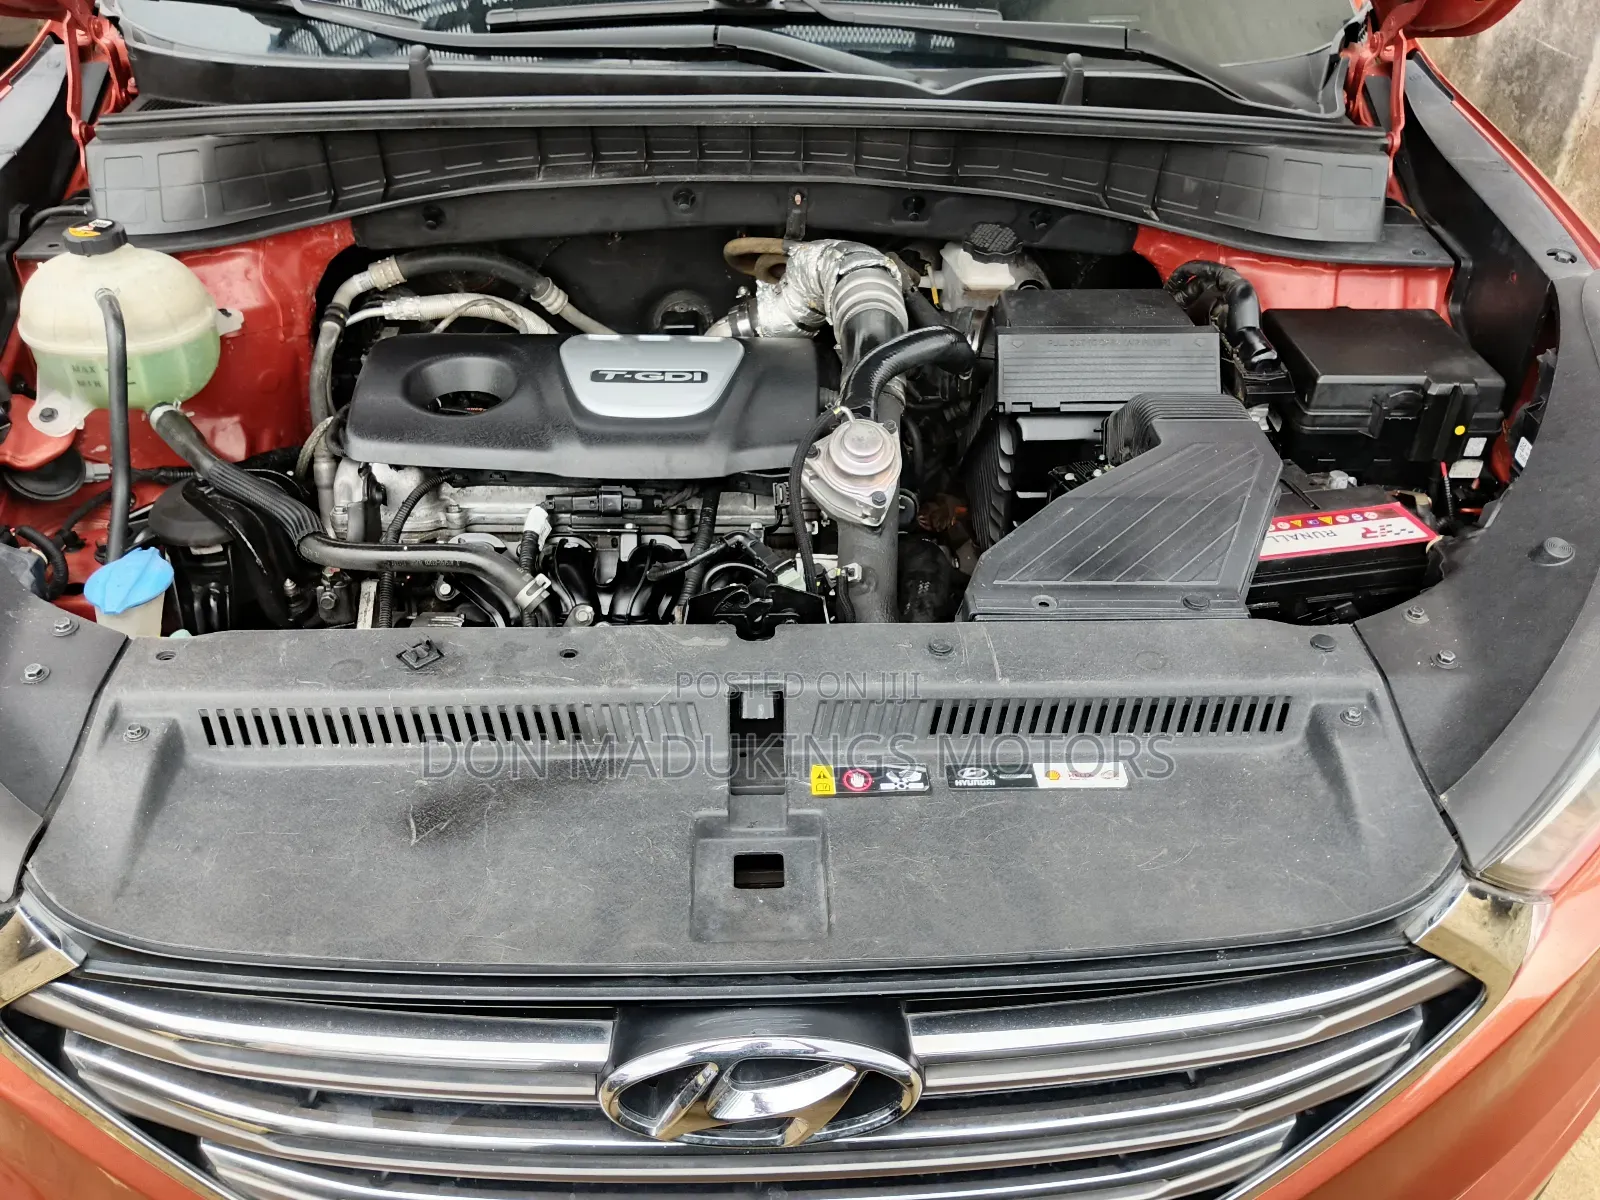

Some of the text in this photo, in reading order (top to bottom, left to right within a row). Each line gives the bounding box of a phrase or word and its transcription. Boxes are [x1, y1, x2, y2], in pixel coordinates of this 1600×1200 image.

[71, 364, 97, 374] MAX
[598, 370, 702, 382] T-GDI
[1266, 529, 1338, 544] RUNALL
[954, 779, 996, 787] HYUNDAI
